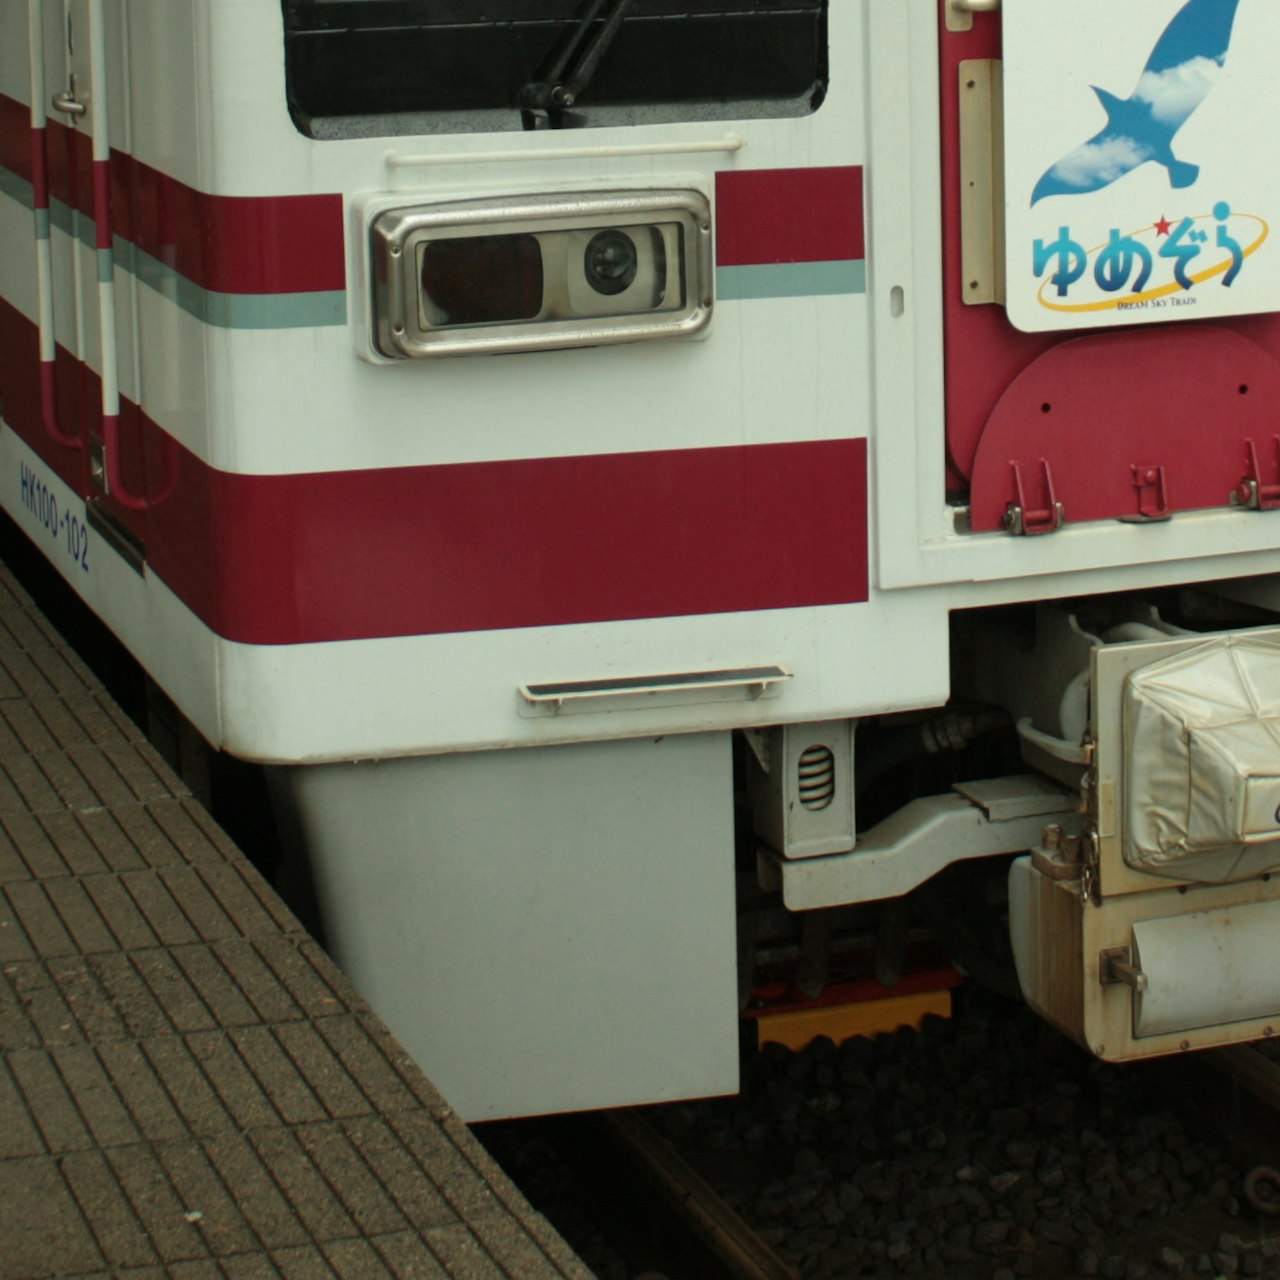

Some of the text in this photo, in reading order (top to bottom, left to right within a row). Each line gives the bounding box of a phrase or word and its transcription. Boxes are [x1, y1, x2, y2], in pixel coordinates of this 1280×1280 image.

[1032, 201, 1244, 297] ゆめぞら
[1169, 296, 1197, 307] TRAIN
[20, 460, 89, 573] HK100-102
